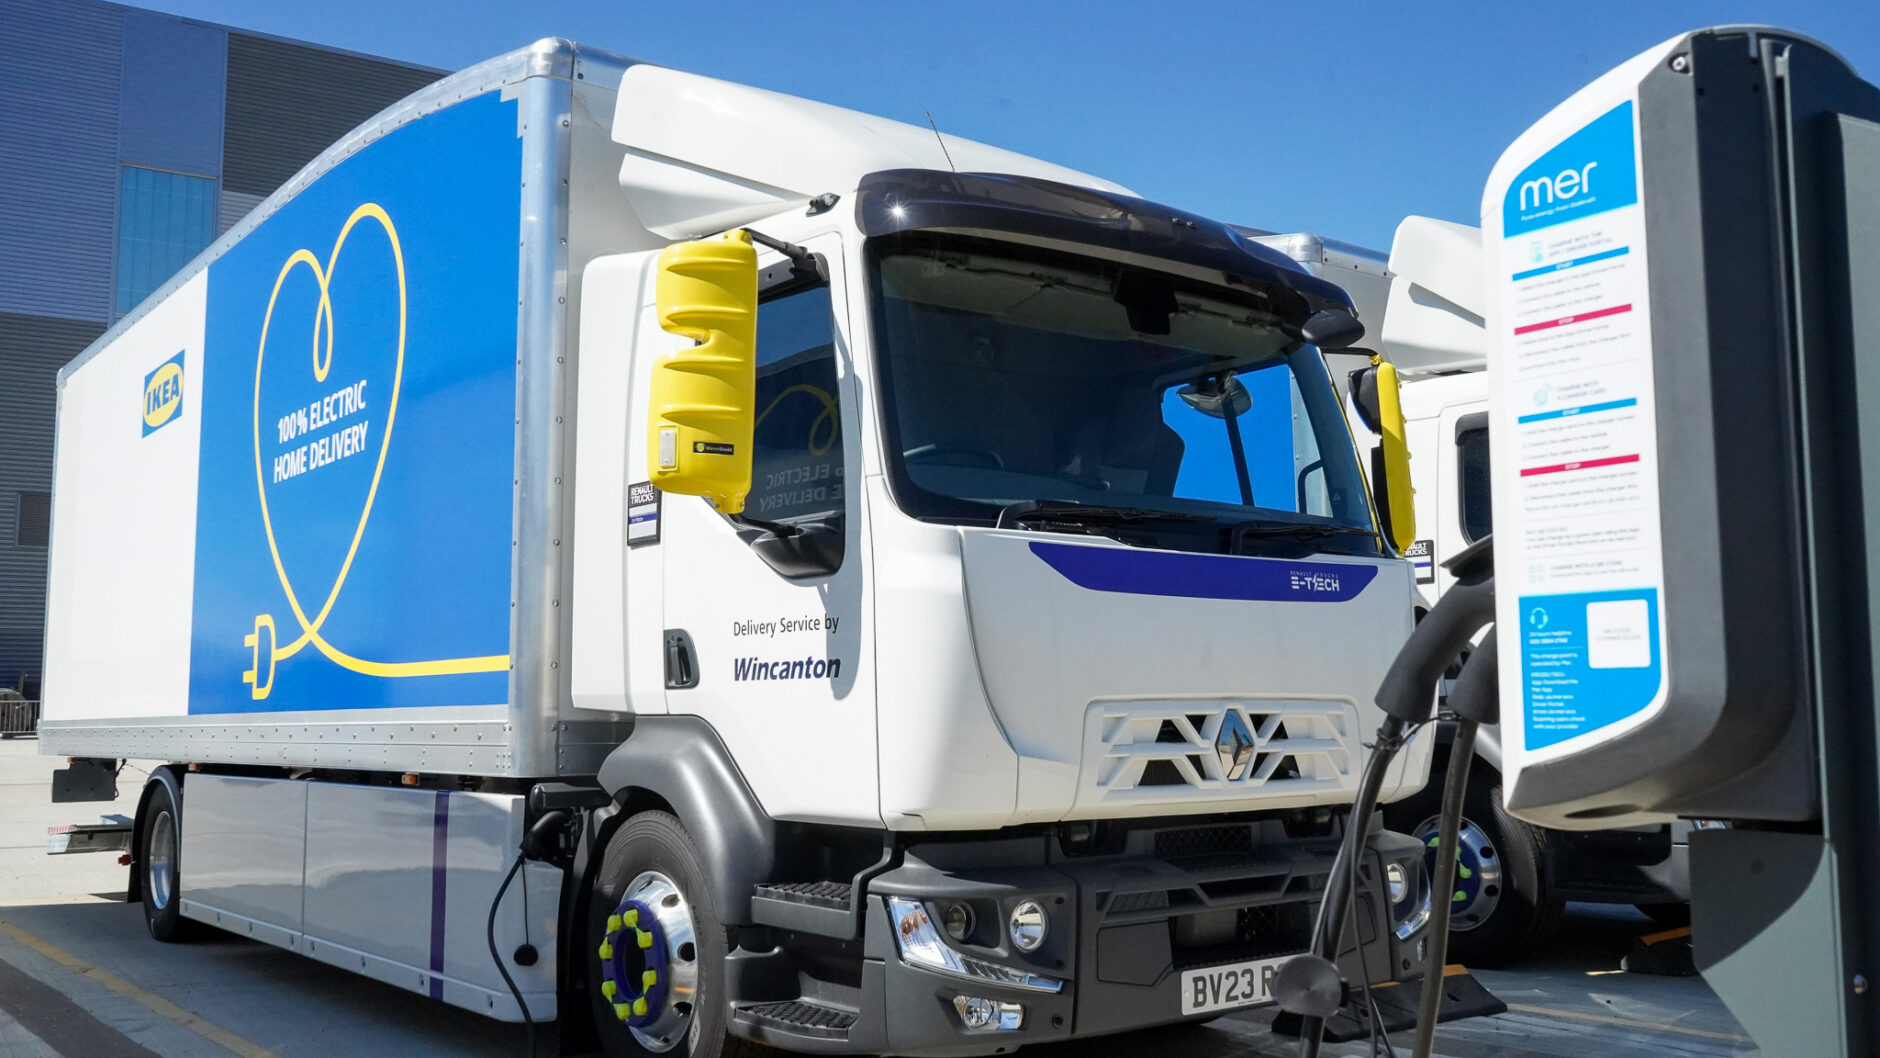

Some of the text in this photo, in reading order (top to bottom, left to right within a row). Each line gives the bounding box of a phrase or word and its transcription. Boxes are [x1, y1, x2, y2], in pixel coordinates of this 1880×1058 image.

[1520, 161, 1598, 211] mer
[146, 373, 180, 416] IKEA
[278, 379, 367, 444] 100% ELECTRIC
[273, 420, 369, 484] HOME DELIVERY
[630, 483, 654, 496] RENAULT
[630, 492, 654, 504] TRUCKS
[1291, 575, 1340, 592] E-TECH
[733, 613, 840, 638] Delivery Service by
[734, 655, 841, 682] Wincanton
[1192, 968, 1255, 1009] BV23
